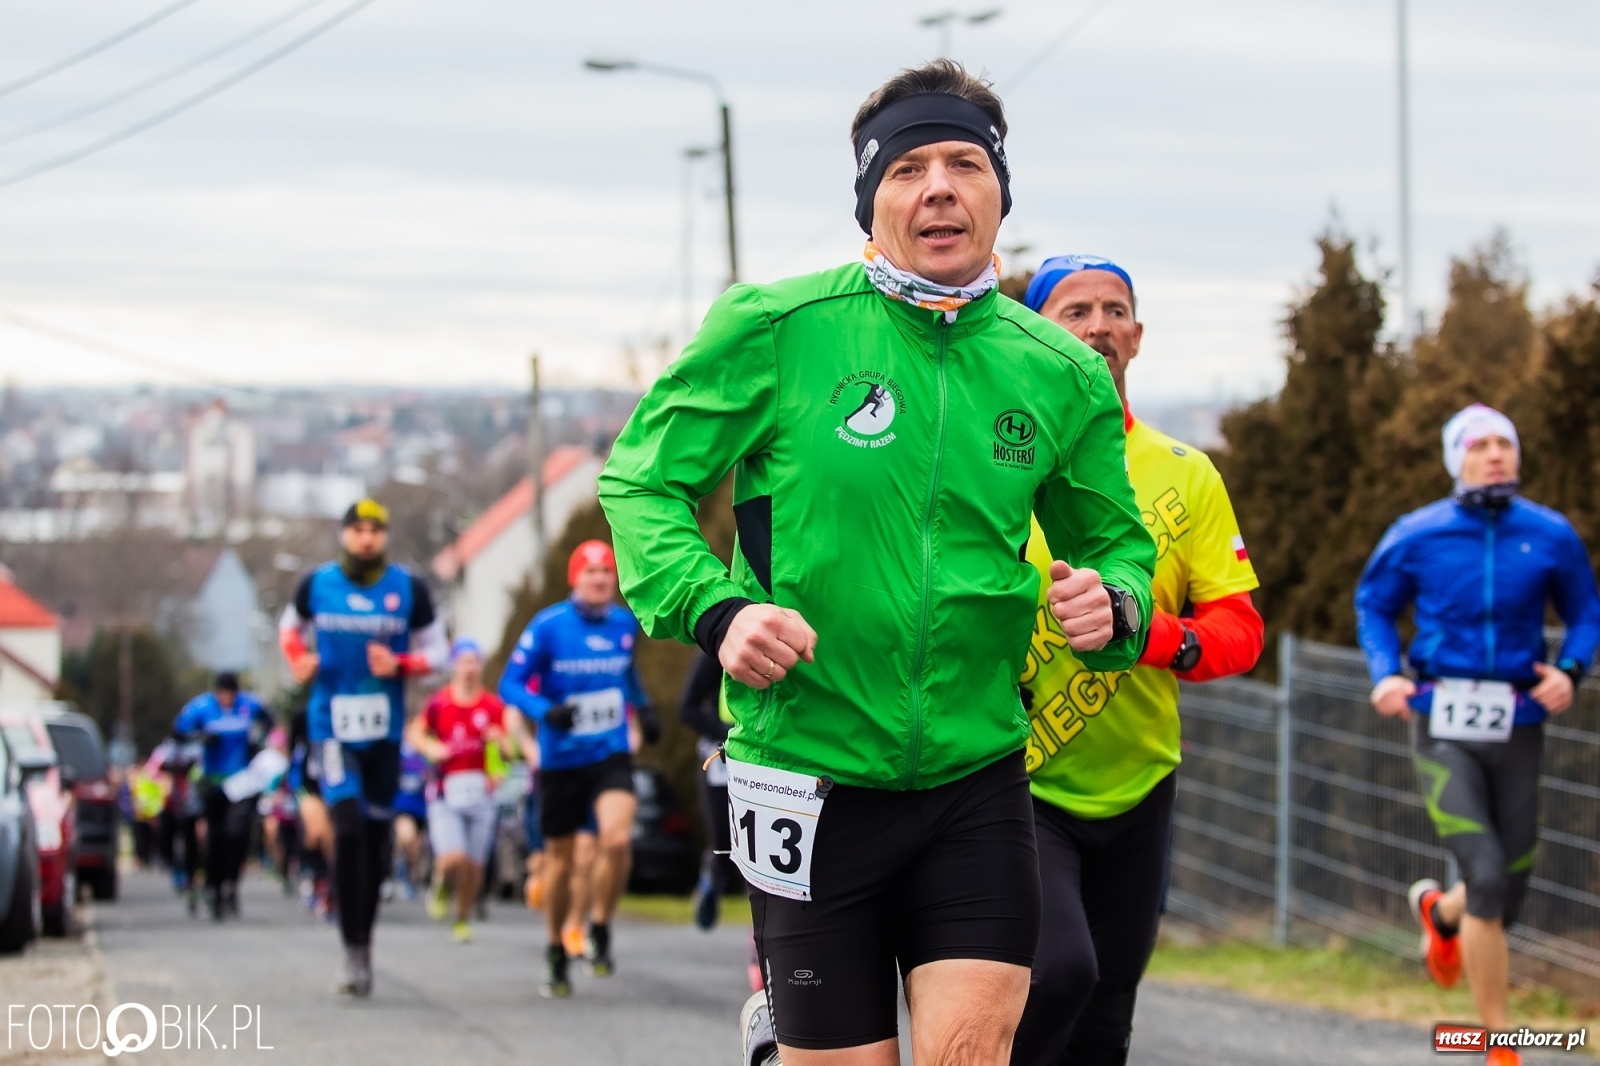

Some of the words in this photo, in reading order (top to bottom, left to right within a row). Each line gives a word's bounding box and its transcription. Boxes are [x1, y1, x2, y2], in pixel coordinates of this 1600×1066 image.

[830, 373, 857, 405] RYBNICKA
[859, 370, 885, 382] GRUPA
[887, 378, 907, 415] BIEGOWA
[835, 425, 869, 448] PĘDZIMY
[870, 431, 897, 448] RAZEM
[993, 440, 1036, 465] HOSTERSI
[1443, 702, 1506, 730] 122
[788, 978, 822, 987] Kalenji
